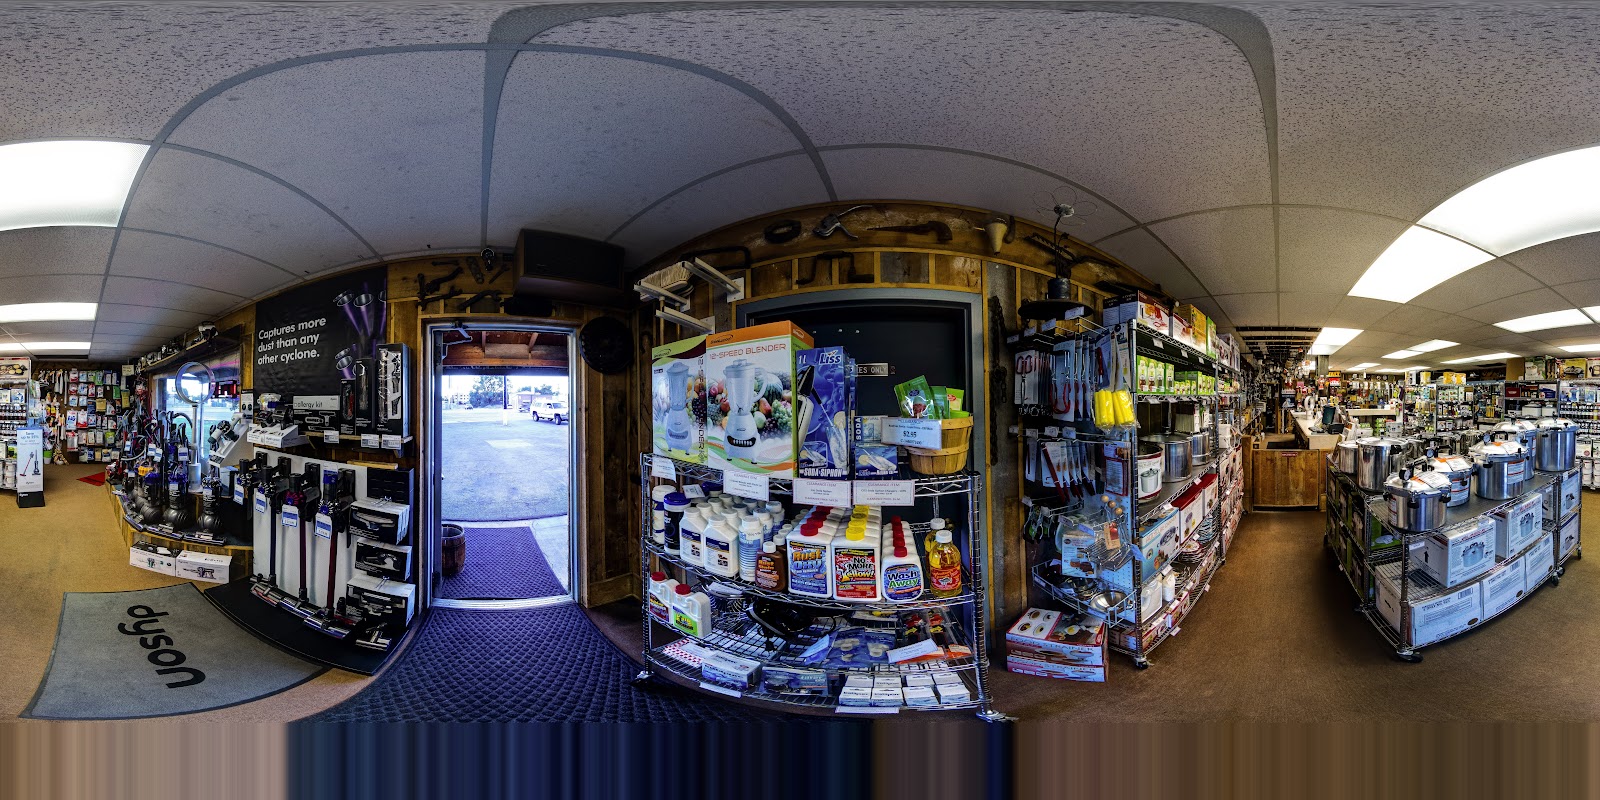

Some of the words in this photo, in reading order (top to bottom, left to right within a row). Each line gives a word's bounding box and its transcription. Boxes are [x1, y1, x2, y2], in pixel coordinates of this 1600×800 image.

[258, 324, 296, 340] Captures
[298, 317, 326, 330] more
[257, 340, 275, 353] dust
[276, 337, 297, 350] than
[300, 333, 320, 346] any
[257, 354, 278, 366] other
[280, 349, 320, 364] cyclone.
[710, 349, 744, 360] 12-SPEED
[745, 343, 787, 354] BLENDER
[857, 366, 868, 374] ES
[870, 366, 888, 374] ONLY
[792, 549, 822, 561] Rust
[793, 560, 822, 570] OXY
[887, 571, 918, 580] Wash
[888, 578, 919, 588] Away
[117, 604, 207, 689] dyson
